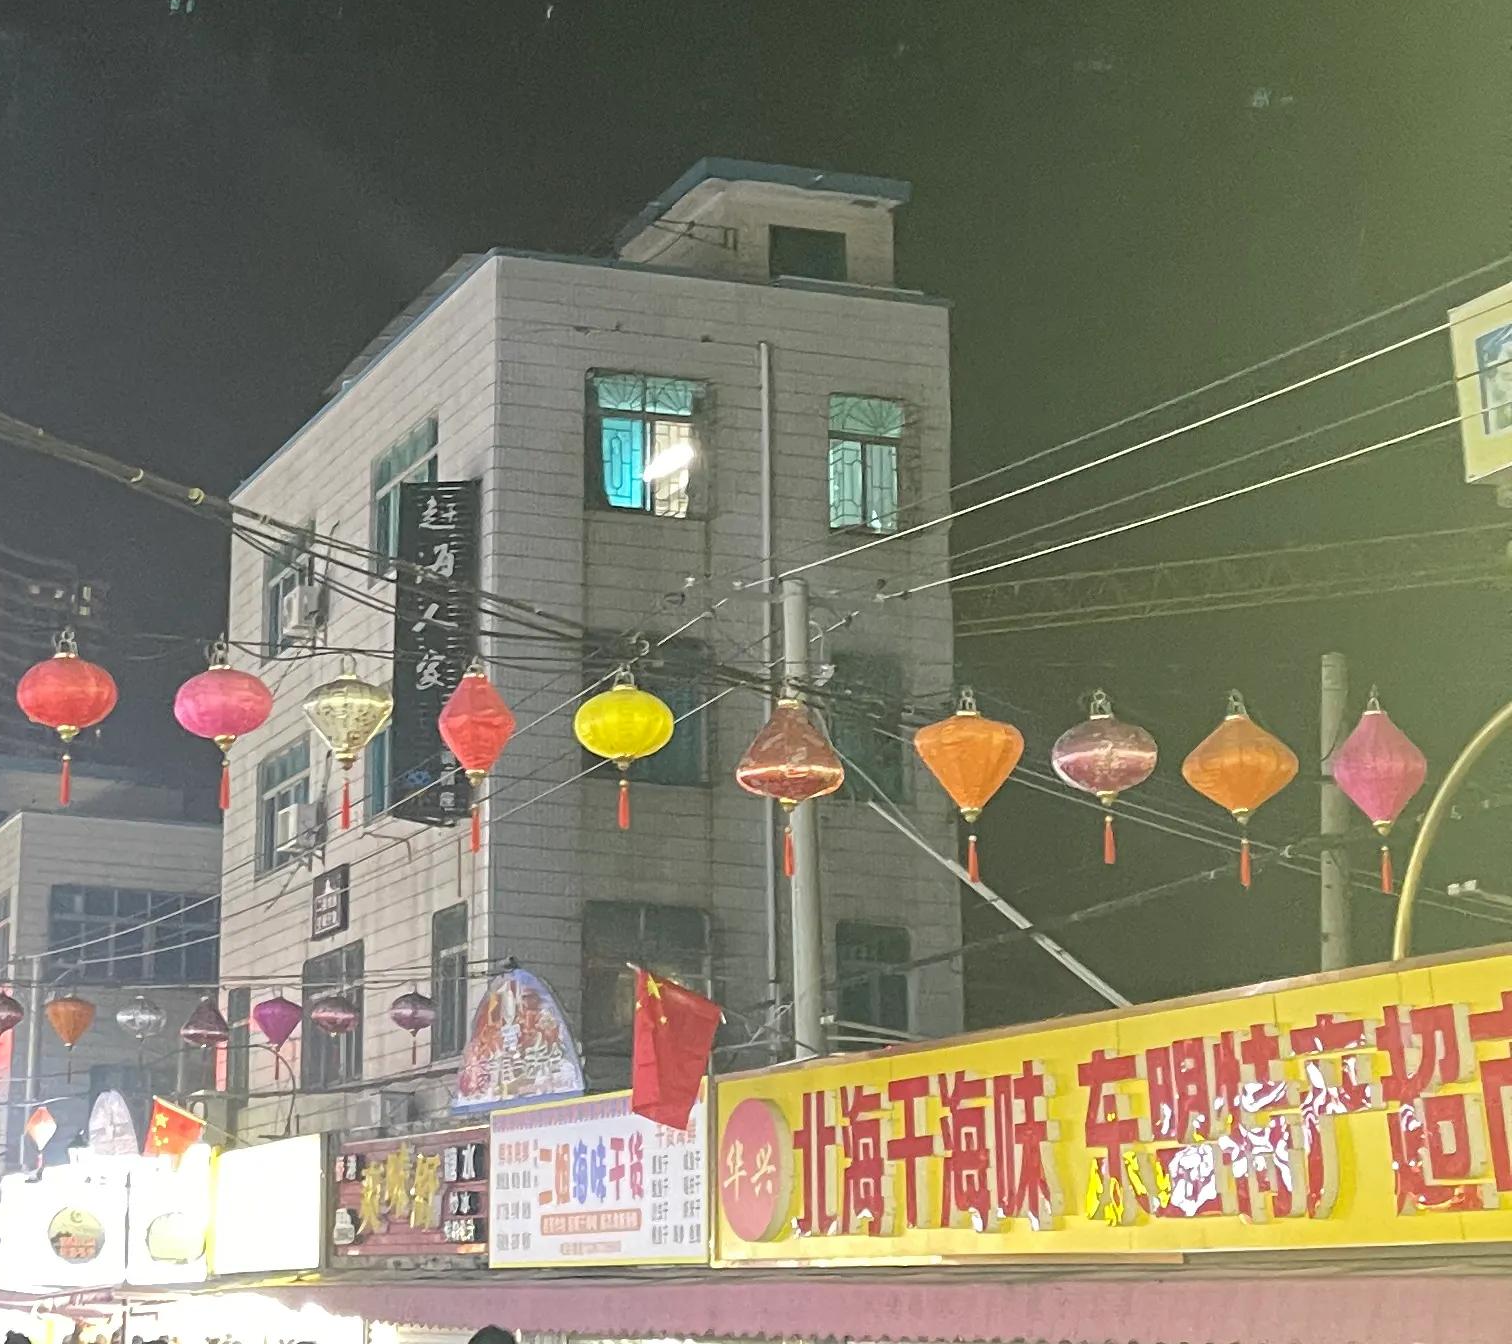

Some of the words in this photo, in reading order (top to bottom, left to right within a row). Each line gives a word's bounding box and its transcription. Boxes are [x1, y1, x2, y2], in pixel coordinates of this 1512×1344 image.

[722, 1138, 777, 1201] 华兴
[792, 1060, 1054, 1239] 北海干海味
